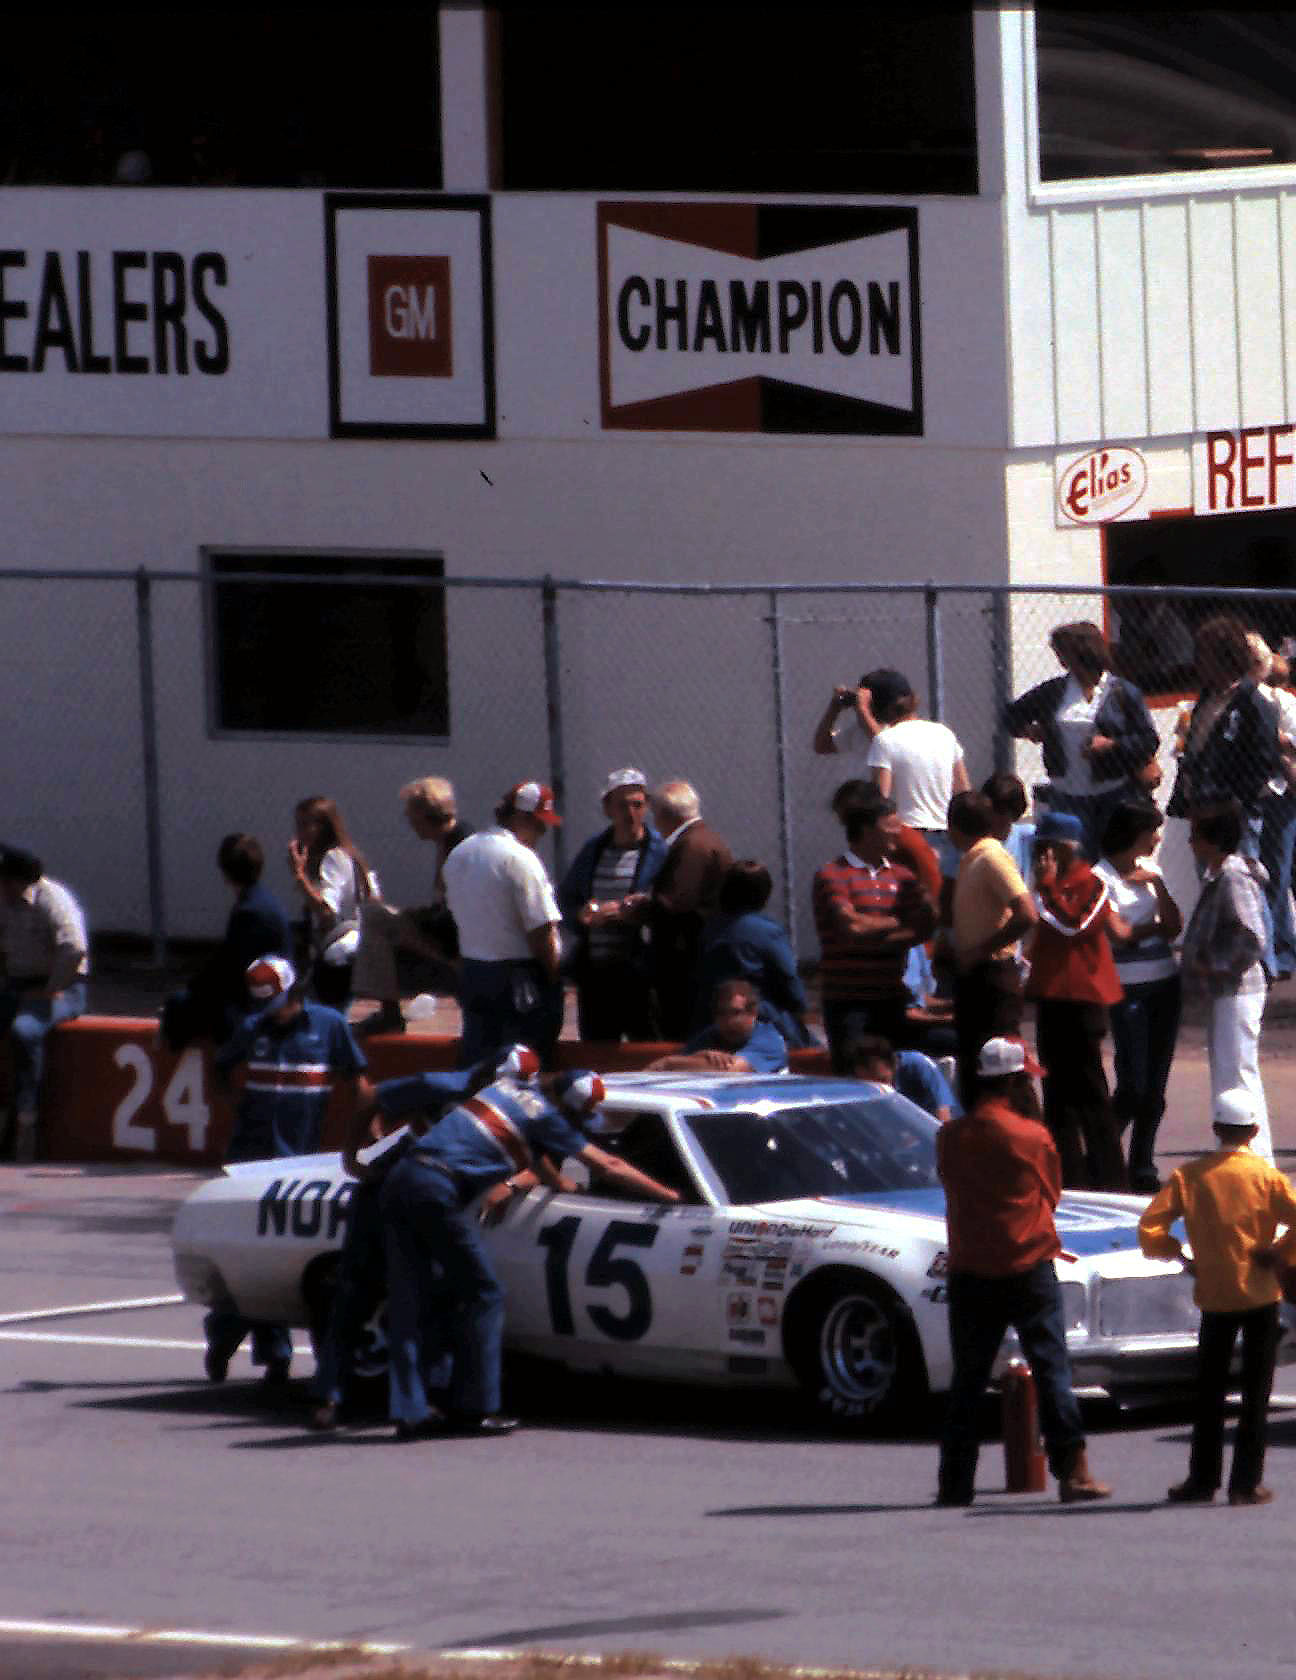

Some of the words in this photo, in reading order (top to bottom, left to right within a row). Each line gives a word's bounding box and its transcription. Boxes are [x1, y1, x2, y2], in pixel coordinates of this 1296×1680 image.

[0, 251, 229, 375] EALERS
[384, 285, 436, 340] GM
[617, 276, 900, 356] CHAMPION
[112, 1043, 210, 1151] 24
[537, 1215, 659, 1341] 15
